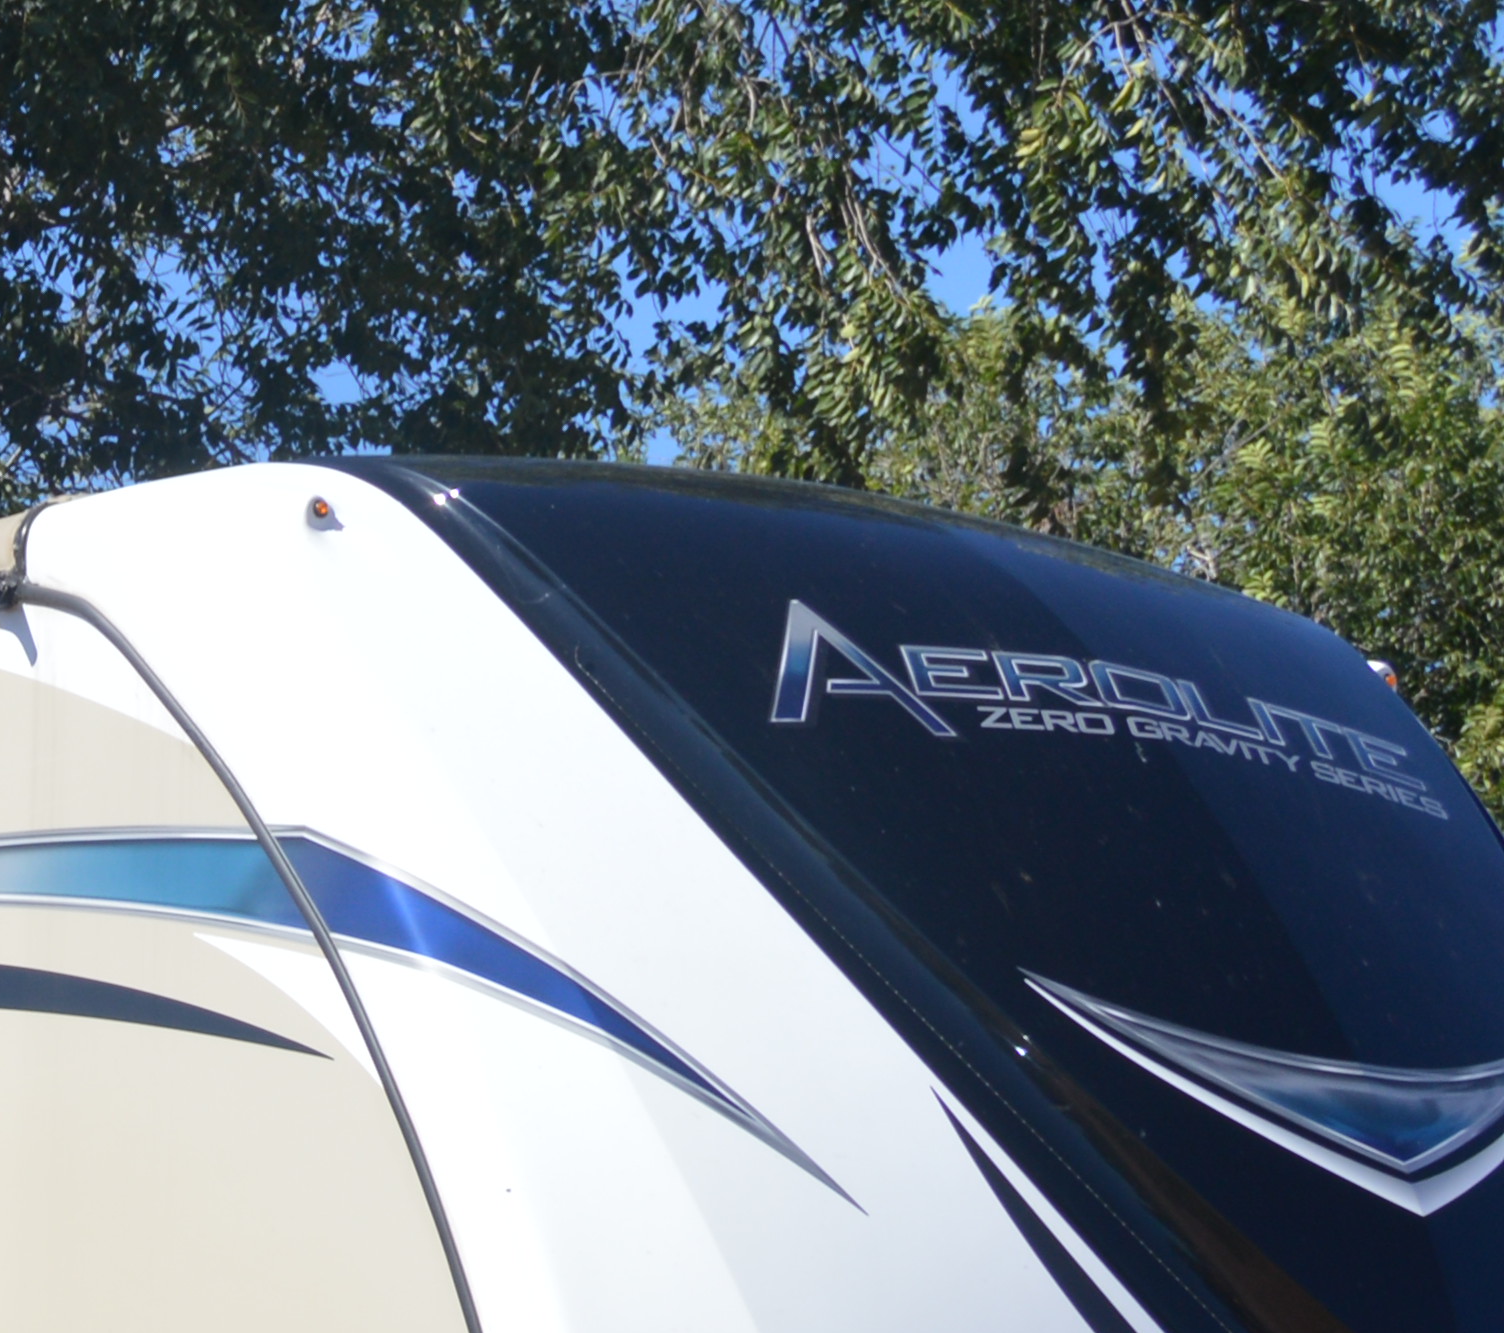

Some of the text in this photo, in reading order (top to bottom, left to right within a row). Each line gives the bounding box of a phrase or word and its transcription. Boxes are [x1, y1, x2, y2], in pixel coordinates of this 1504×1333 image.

[977, 705, 1448, 820] ZERO GRAVITY SERIES
